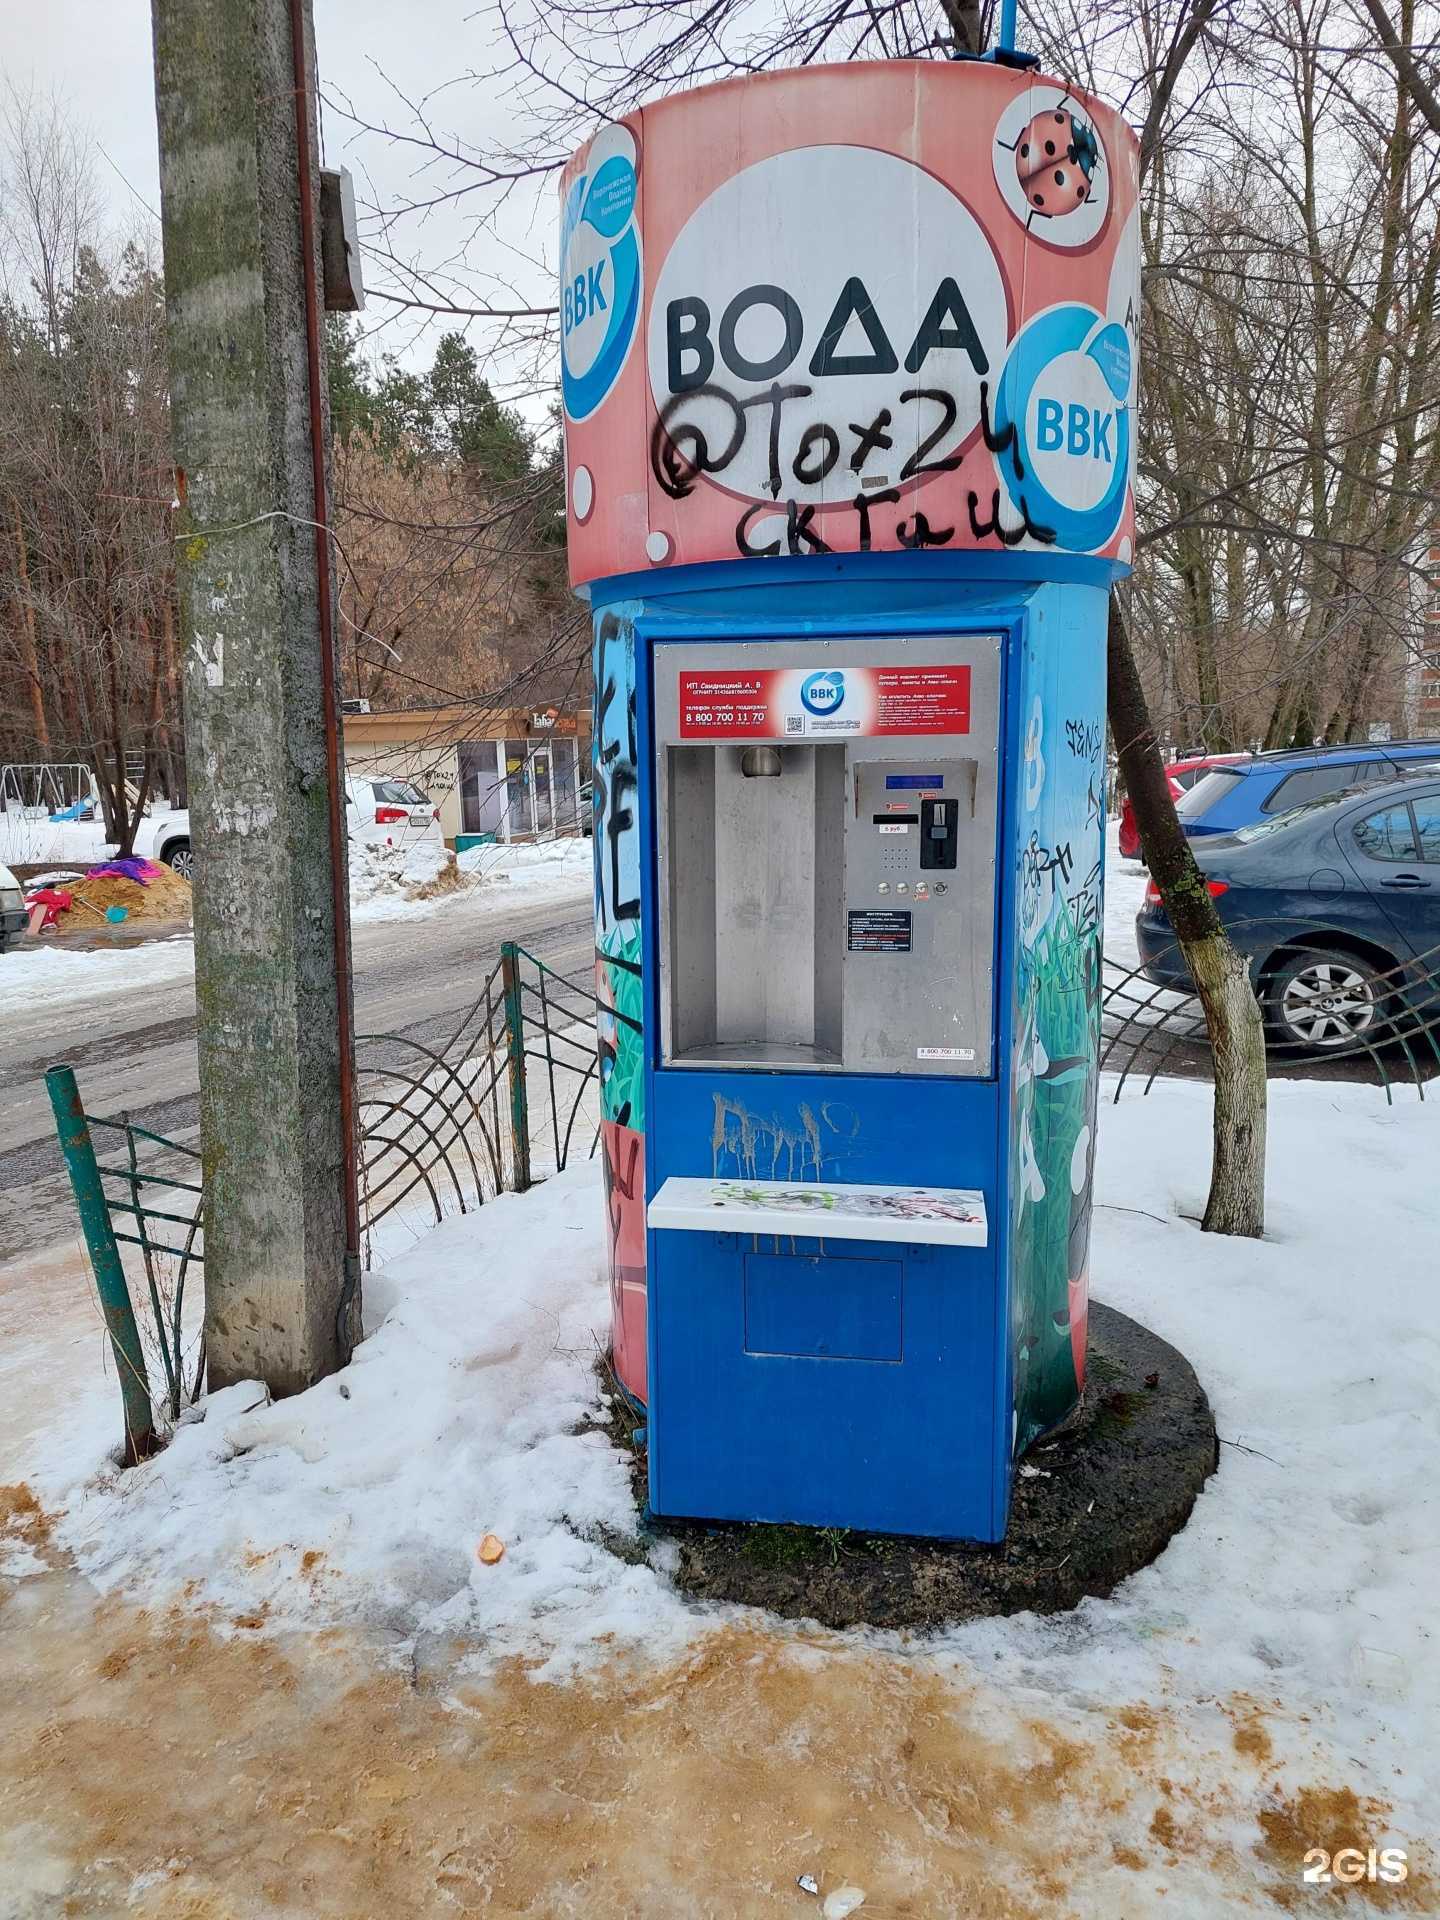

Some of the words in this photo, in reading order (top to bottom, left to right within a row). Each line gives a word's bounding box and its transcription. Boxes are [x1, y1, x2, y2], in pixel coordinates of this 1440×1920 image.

[667, 276, 990, 394] ВОДА
[1037, 398, 1112, 463] ВВК
[810, 688, 835, 699] ВВК
[712, 703, 734, 711] службы
[686, 713, 692, 721] 8
[695, 713, 713, 721] 800
[716, 713, 733, 721] 700
[737, 713, 747, 721] 11
[752, 712, 764, 721] 70
